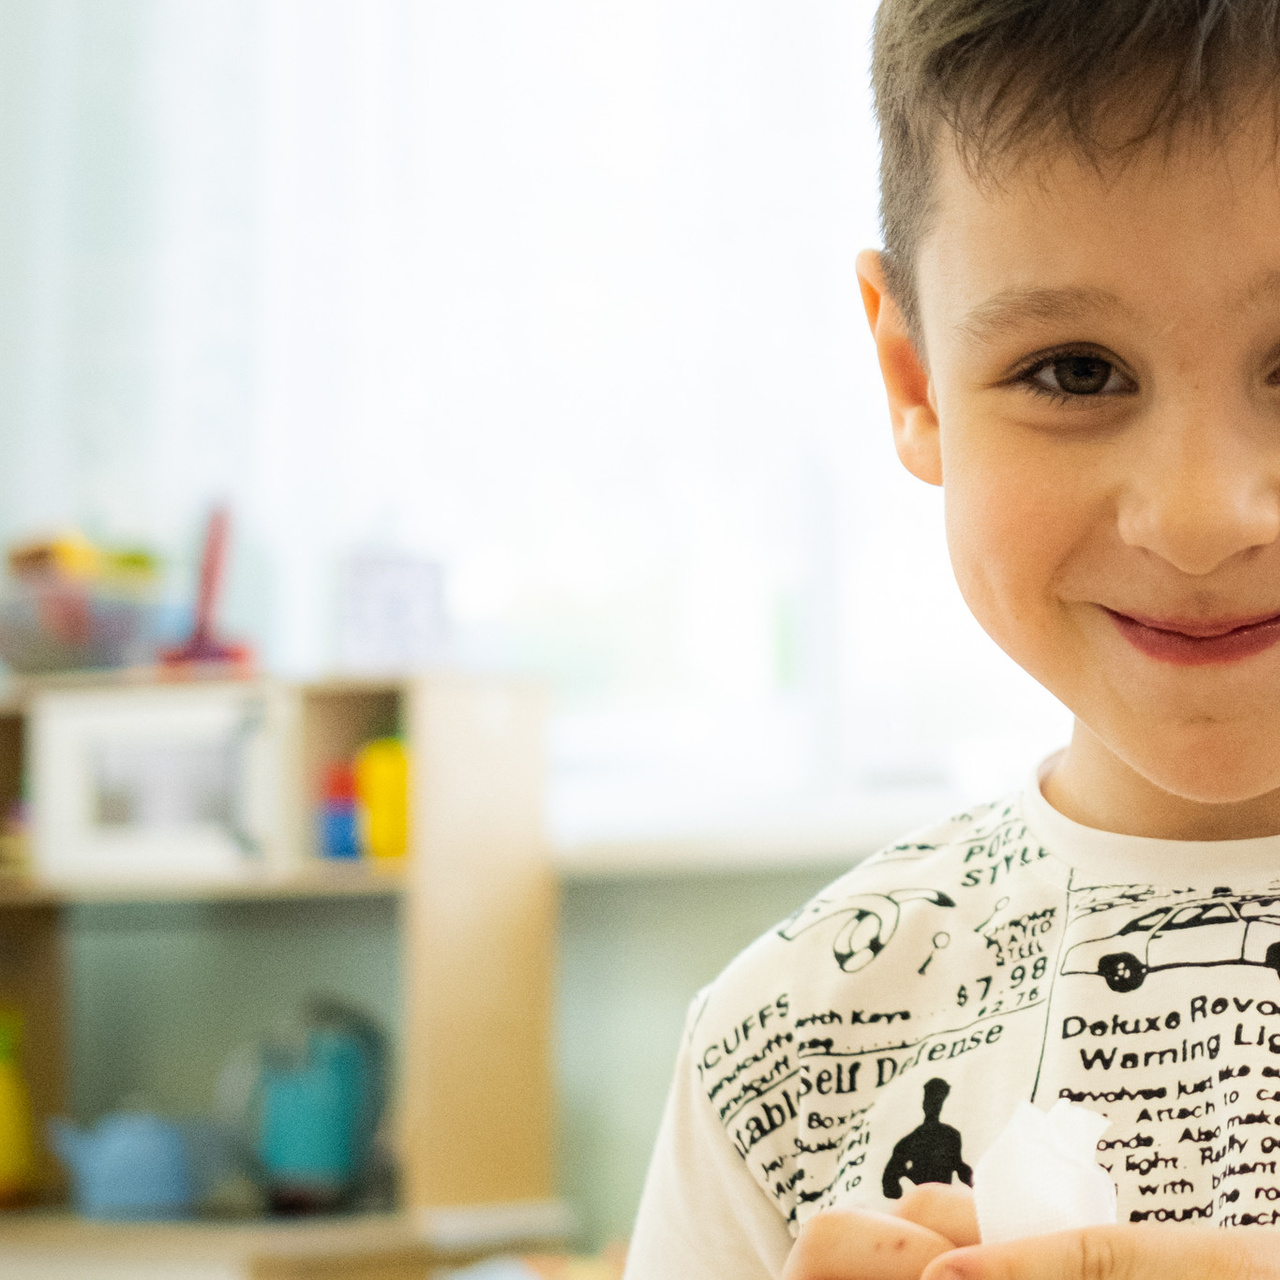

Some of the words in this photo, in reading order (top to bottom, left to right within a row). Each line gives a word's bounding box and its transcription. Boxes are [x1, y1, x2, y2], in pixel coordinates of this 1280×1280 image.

[699, 993, 790, 1076] CUFFS
[1061, 1011, 1182, 1039] Deluxe
[875, 1023, 1004, 1088] Defense
[1079, 1034, 1221, 1071] Warning
